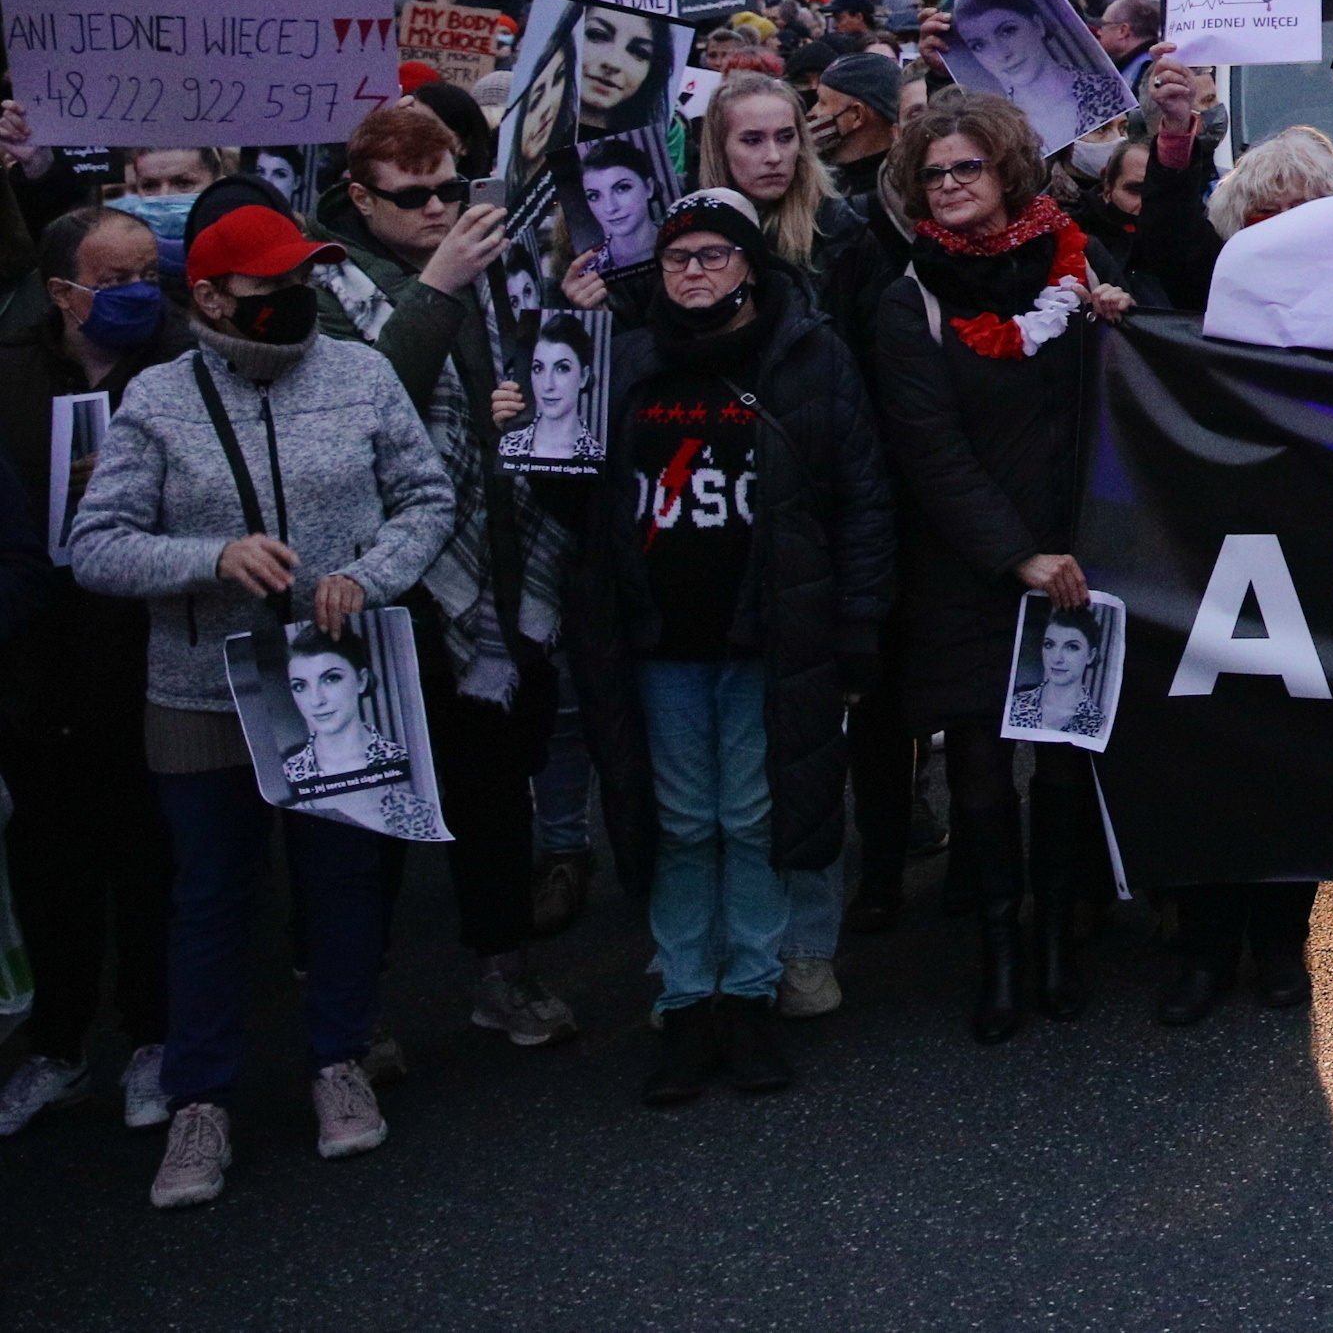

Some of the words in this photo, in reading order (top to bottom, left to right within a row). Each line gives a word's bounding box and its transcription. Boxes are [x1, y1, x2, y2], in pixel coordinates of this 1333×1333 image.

[410, 6, 444, 27] MY
[1168, 20, 1195, 36] #ANI
[1202, 17, 1245, 29] JEDNEJ
[1253, 16, 1298, 30] WIĘCEJ
[8, 14, 58, 51] ANI
[69, 13, 187, 55] JEDNEJ
[203, 16, 319, 59] WIĘCEJ
[98, 75, 163, 123] 222
[182, 77, 245, 123] 922
[264, 82, 338, 123] 597
